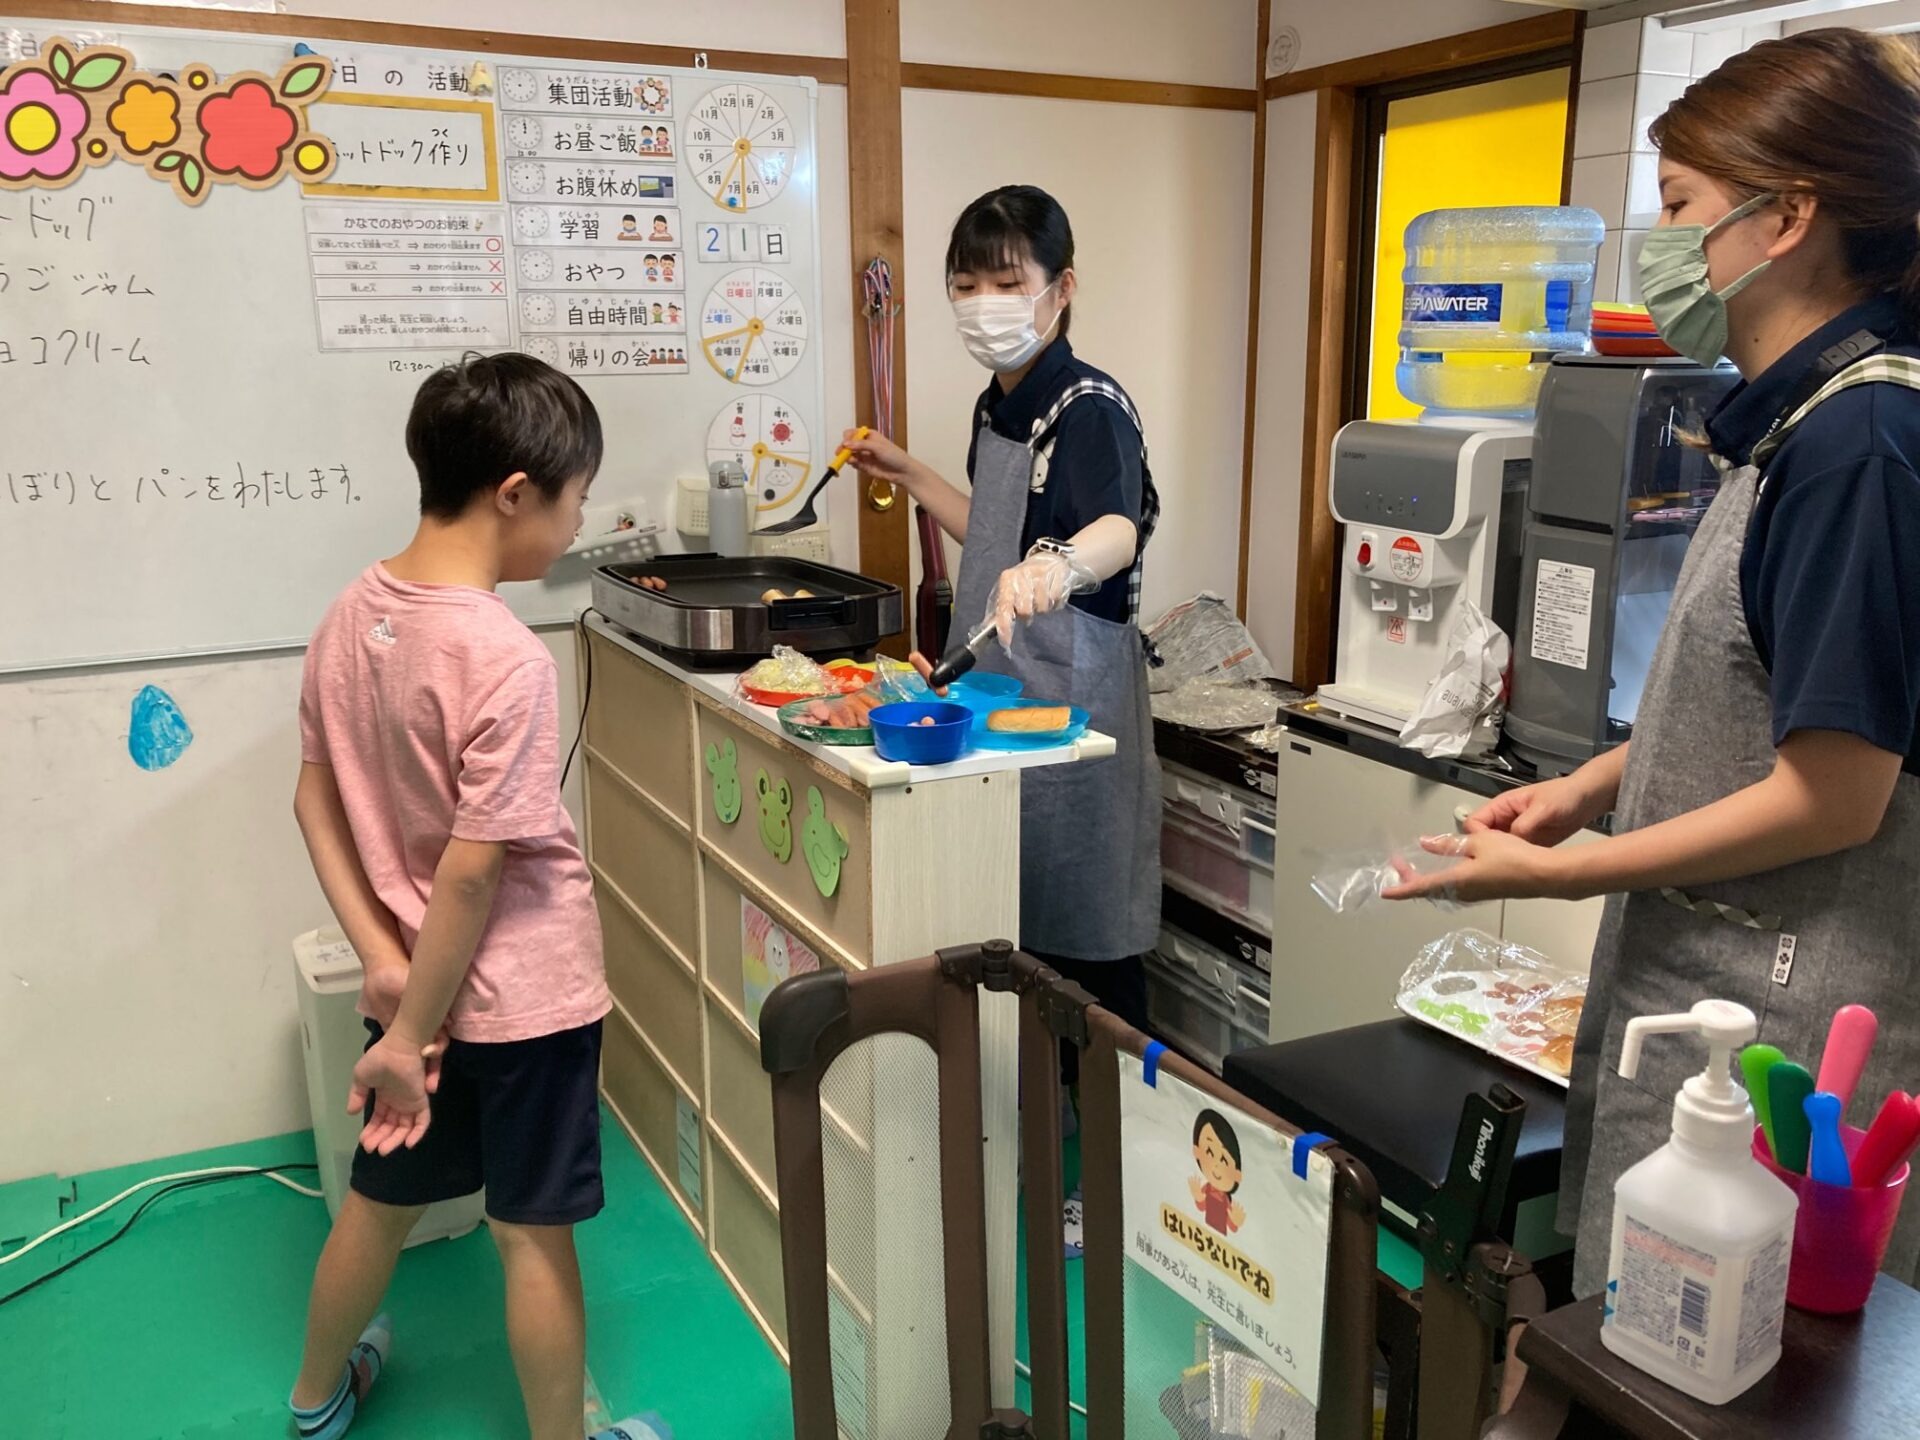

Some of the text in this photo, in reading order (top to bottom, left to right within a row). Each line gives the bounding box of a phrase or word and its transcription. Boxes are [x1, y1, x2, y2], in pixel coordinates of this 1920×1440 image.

[548, 83, 633, 108] 集団活動
[720, 97, 737, 108] 12月
[742, 98, 754, 108] 1月
[701, 109, 718, 120] 11月
[761, 109, 774, 120] 2月
[693, 131, 711, 141] 10月
[771, 131, 784, 141] 3月
[554, 131, 638, 153] お昼ご飯
[328, 138, 468, 167] ットドック作り
[699, 153, 712, 163] 9月
[708, 174, 721, 184] 8月
[556, 176, 638, 197] お腹休め
[728, 184, 741, 194] 7月
[746, 184, 760, 194] 6月
[560, 219, 600, 240] 学習
[564, 263, 625, 282] おやつ
[726, 288, 753, 298] 日曜日
[757, 288, 783, 298] 月曜日
[568, 305, 647, 326] 自由時間
[705, 314, 732, 323] 土曜日
[776, 316, 802, 325] 火曜日
[714, 346, 741, 356] 金曜日
[773, 347, 798, 356] 水曜日
[568, 348, 649, 369] 帰りの会
[744, 364, 769, 374] 木曜日
[1163, 1208, 1271, 1299] はいらないでね
